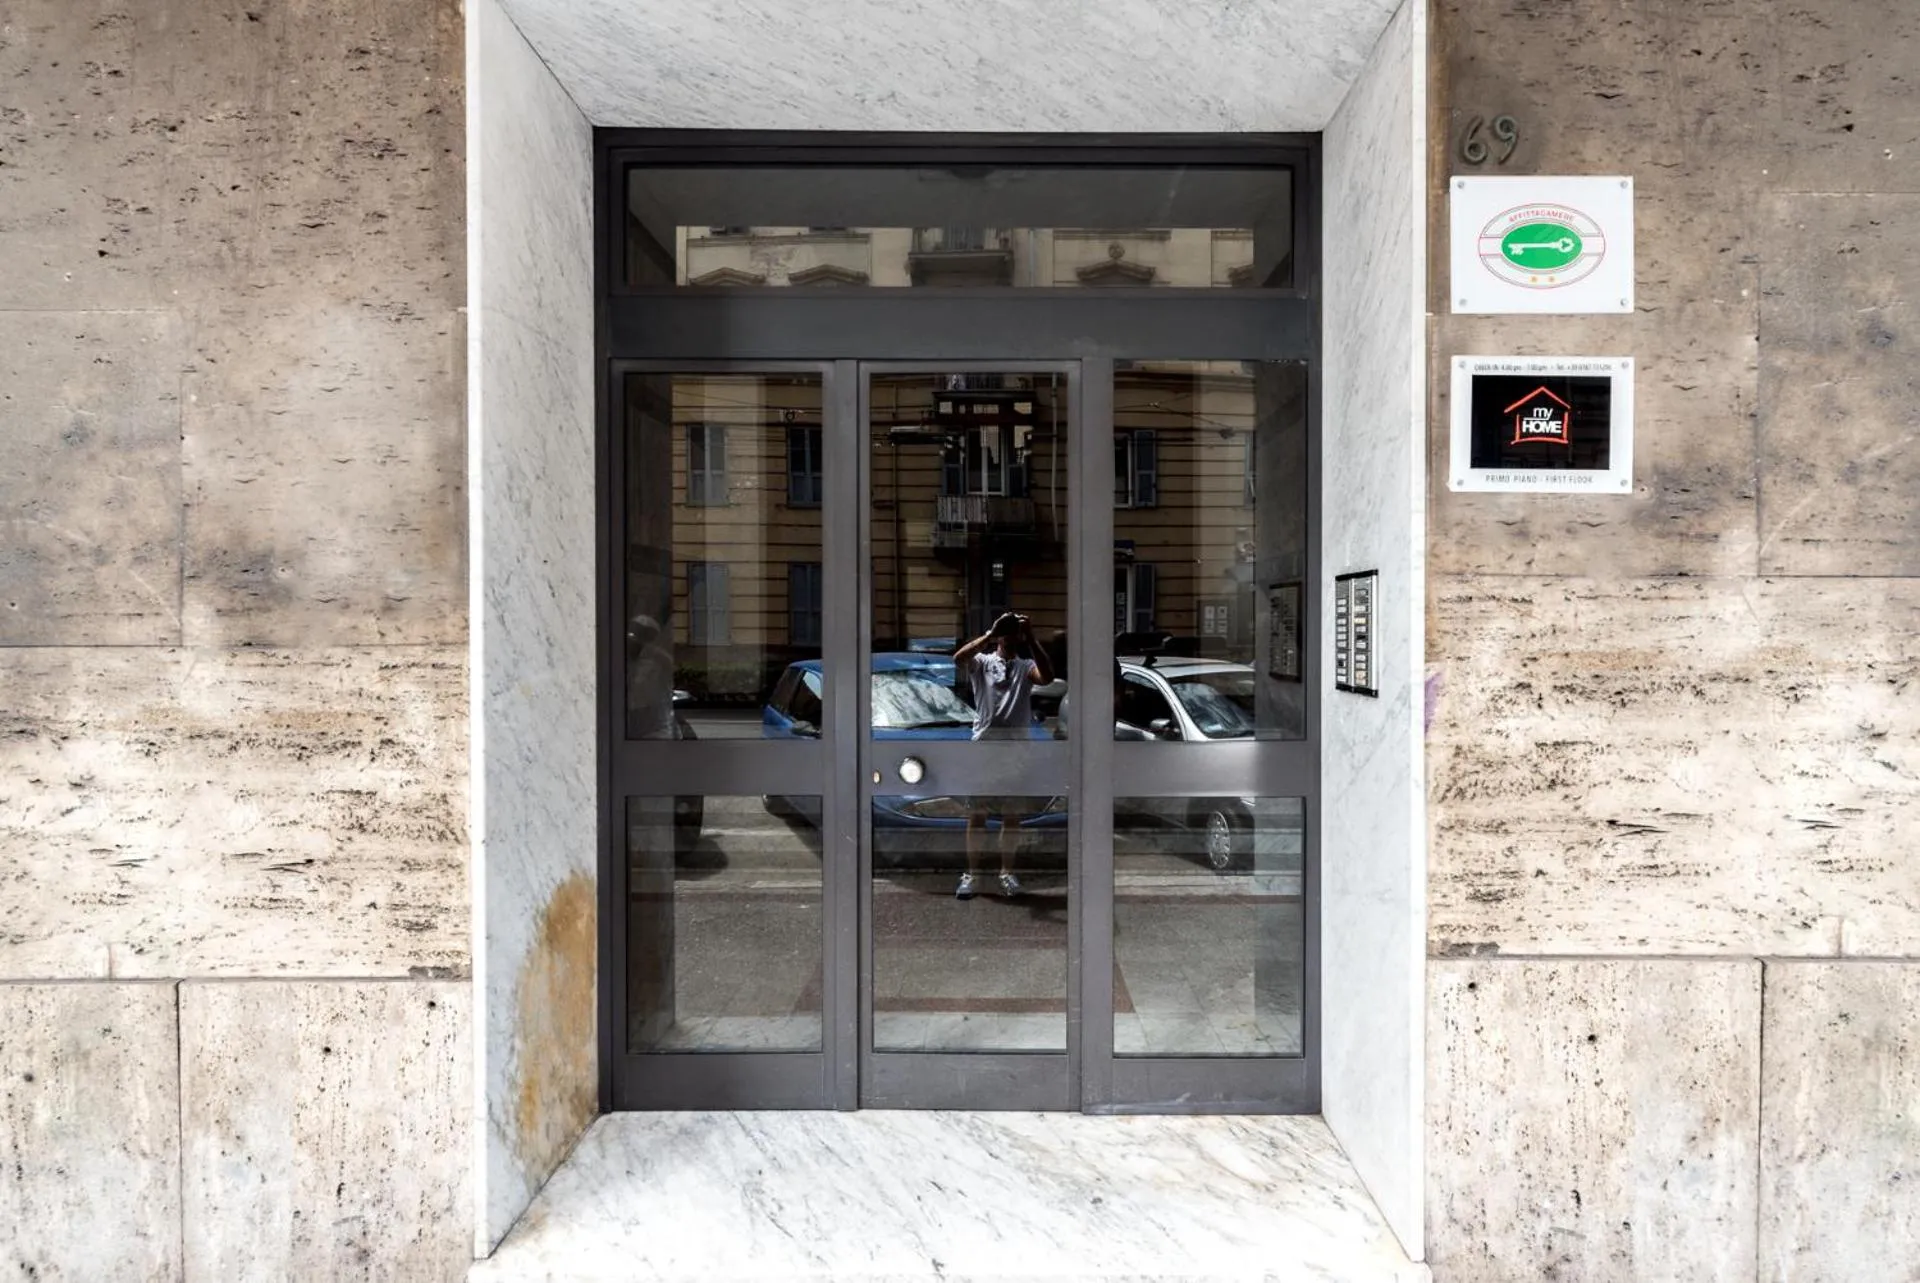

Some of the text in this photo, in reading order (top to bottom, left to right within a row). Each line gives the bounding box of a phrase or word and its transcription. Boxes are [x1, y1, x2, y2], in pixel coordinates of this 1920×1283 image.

[1463, 115, 1518, 165] 69
[1532, 407, 1553, 420] my
[1522, 420, 1562, 433] HOME
[1485, 474, 1510, 483] PRIMO
[1513, 474, 1537, 483] PIANO
